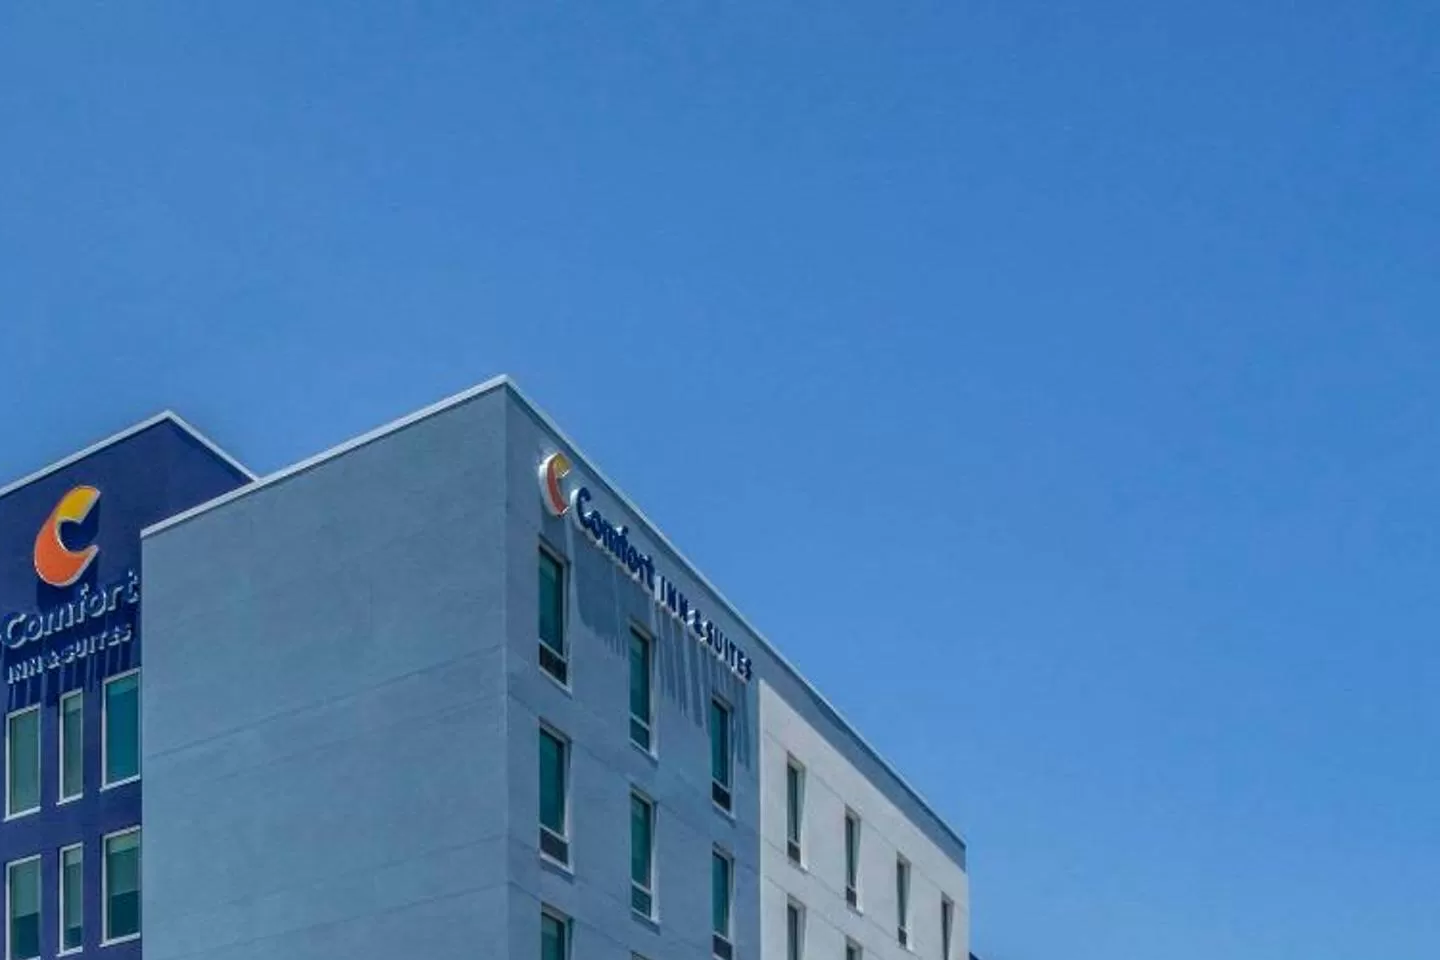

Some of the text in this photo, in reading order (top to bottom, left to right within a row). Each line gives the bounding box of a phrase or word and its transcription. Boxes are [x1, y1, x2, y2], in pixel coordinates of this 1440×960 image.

[5, 569, 139, 648] Comfort
[570, 487, 655, 592] Comfort
[655, 575, 689, 623] INN
[703, 620, 753, 682] SUITES
[6, 655, 44, 684] INN
[61, 623, 133, 664] SUITES
